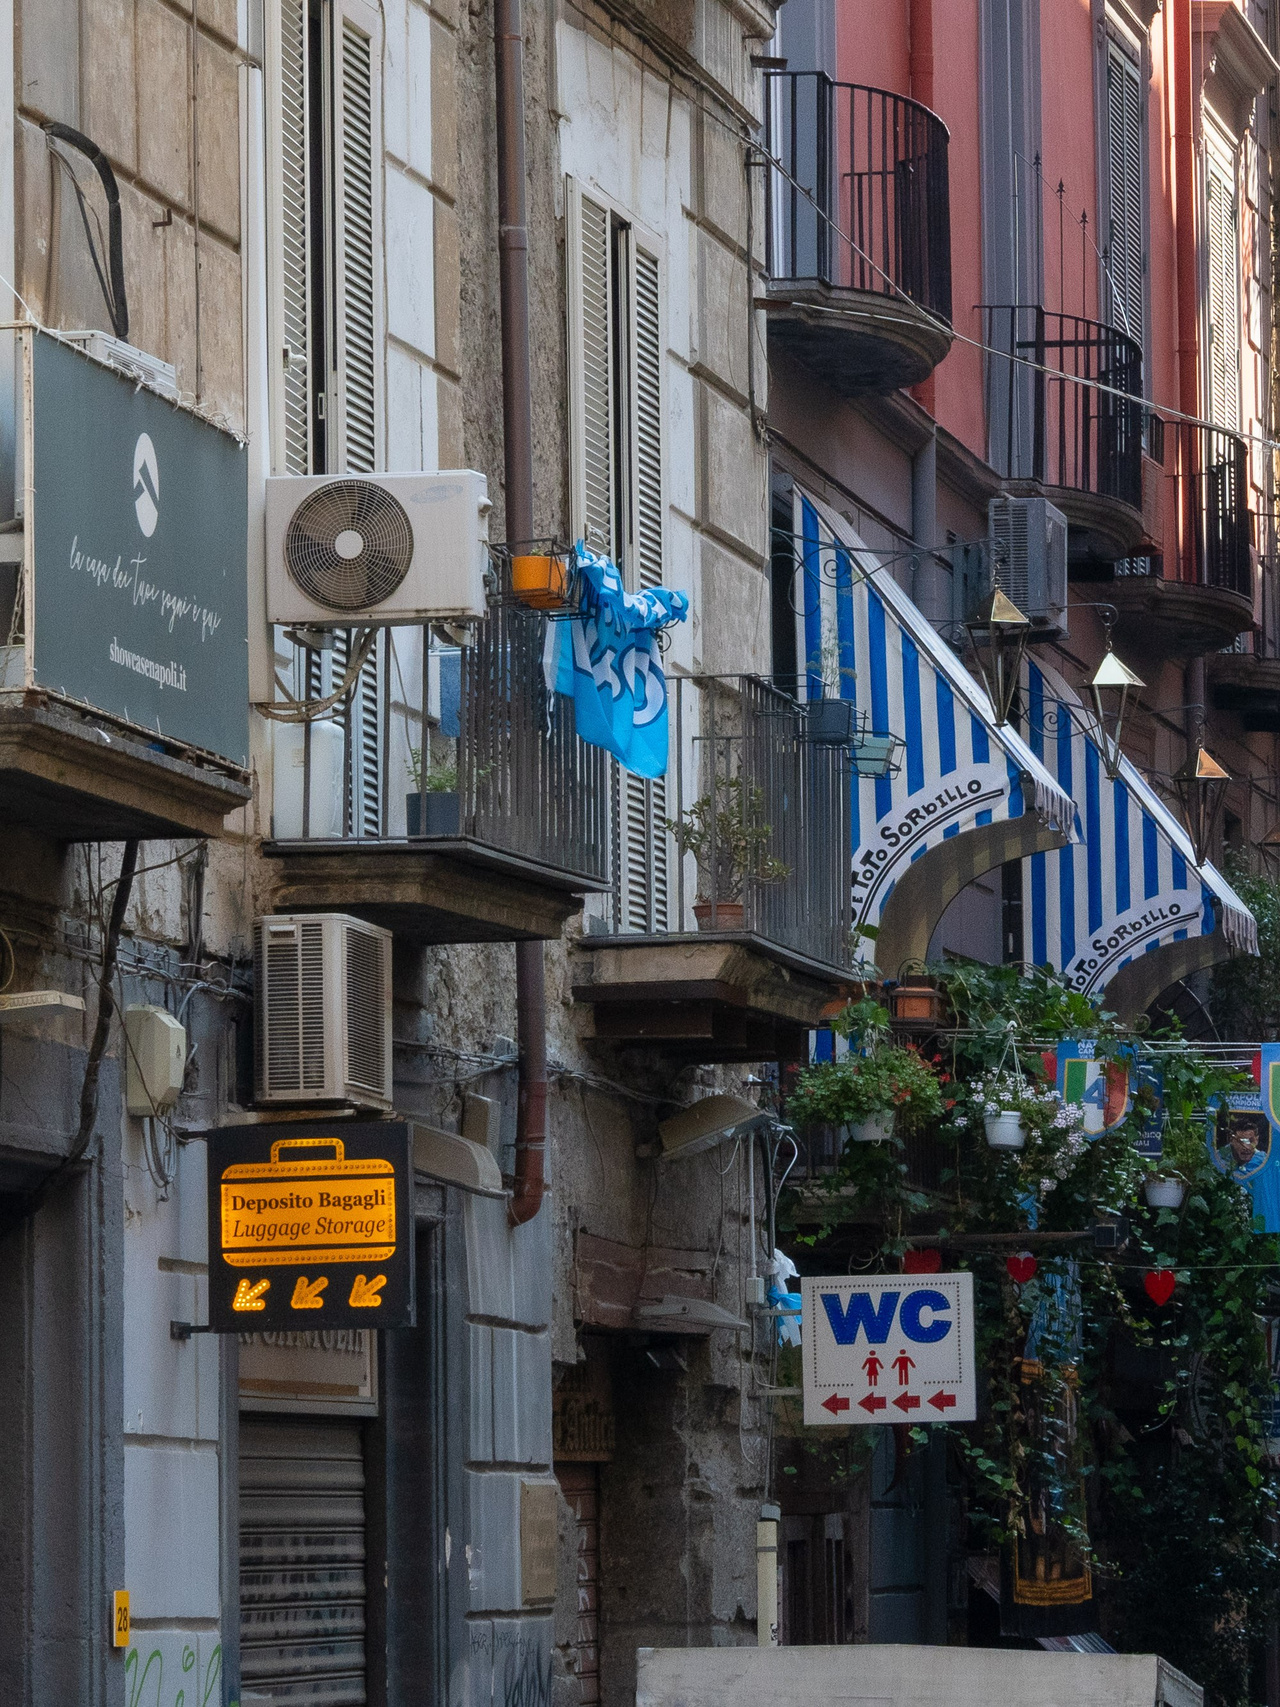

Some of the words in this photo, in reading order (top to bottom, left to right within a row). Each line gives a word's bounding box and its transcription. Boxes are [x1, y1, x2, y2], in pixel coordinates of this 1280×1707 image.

[70, 535, 85, 570] la
[109, 636, 187, 691] showcasenapoli.it
[231, 1192, 313, 1214] Deposito
[318, 1189, 386, 1211] Bagagli
[233, 1220, 311, 1241] Luggage
[315, 1216, 386, 1240] Storage
[819, 1289, 953, 1346] WC
[117, 1606, 129, 1632] 28
